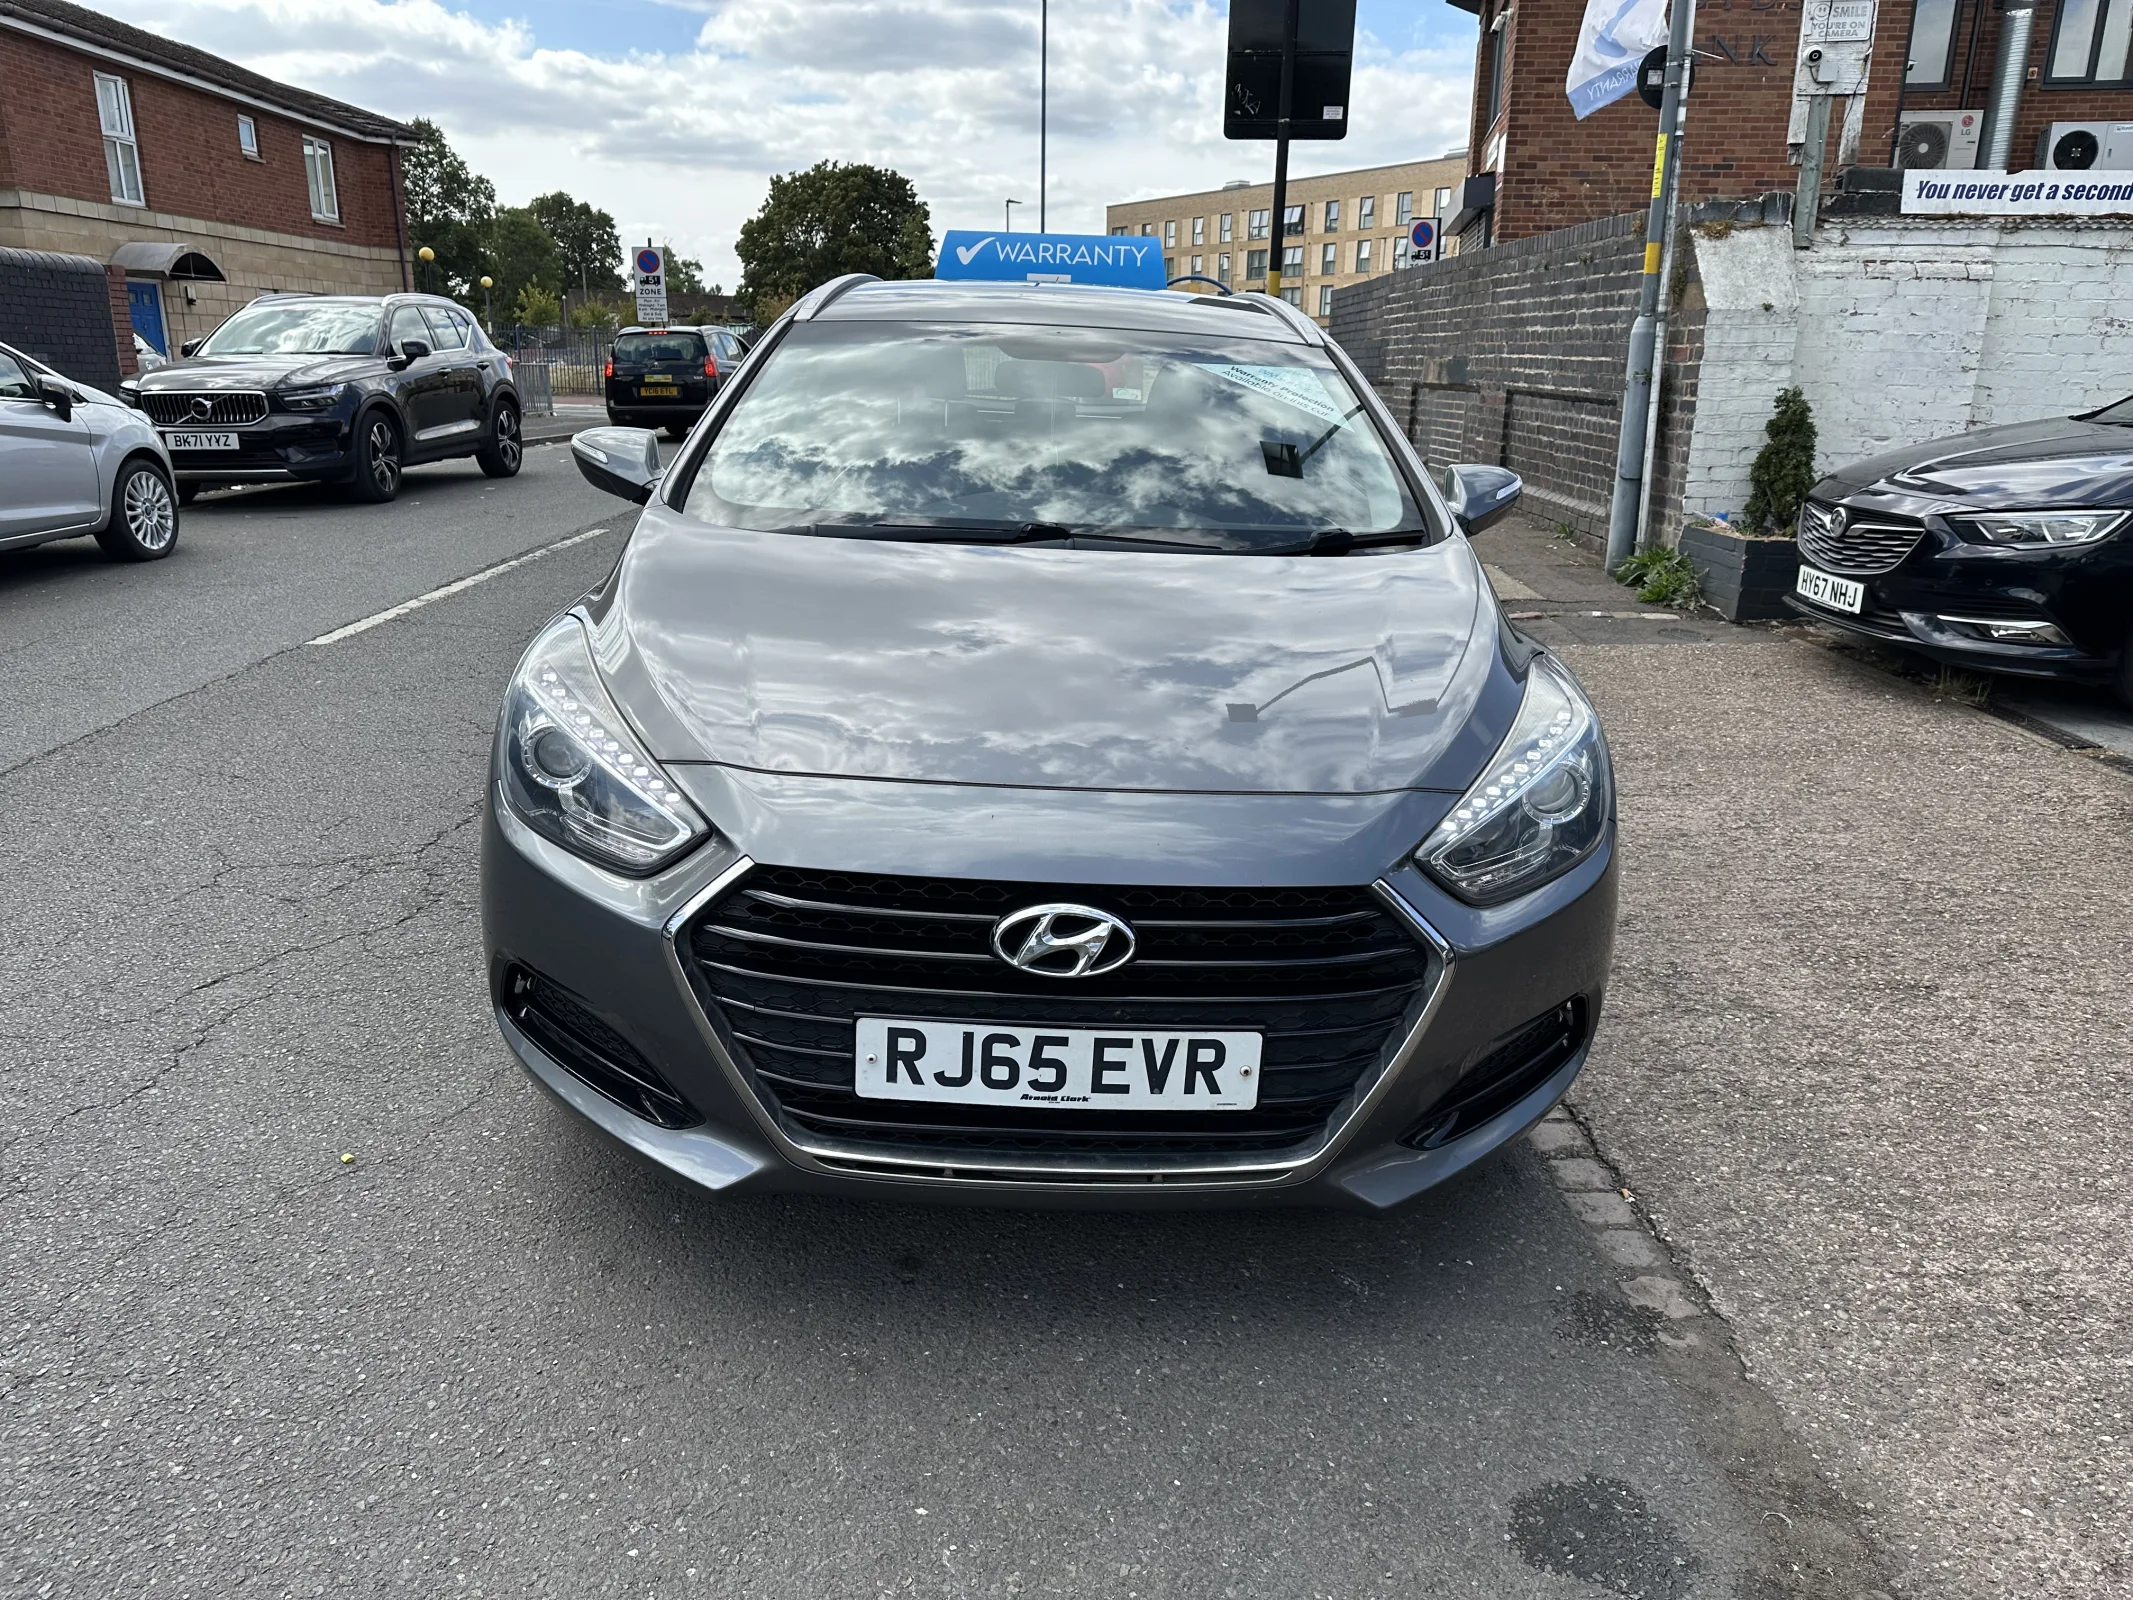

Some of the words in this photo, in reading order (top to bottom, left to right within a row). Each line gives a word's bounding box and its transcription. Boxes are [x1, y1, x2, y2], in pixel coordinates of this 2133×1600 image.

[1833, 6, 1868, 17] SMILE
[1812, 22, 1847, 30] YOU'RE
[1850, 21, 1866, 29] ON
[1961, 128, 1971, 136] LG
[1917, 180, 1951, 200] You
[1952, 182, 2009, 200] never
[2008, 182, 2046, 202] get
[2046, 184, 2060, 200] a
[2062, 182, 2133, 201] second
[996, 241, 1149, 267] WARRANTY
[660, 387, 673, 395] ETL
[1221, 370, 1271, 392] Available
[1272, 391, 1286, 400] on
[1311, 407, 1331, 417] car
[1230, 365, 1279, 388] Warranty
[1280, 386, 1335, 412] Protection
[173, 434, 203, 447] BK71
[204, 434, 231, 447] YYZ
[1801, 570, 1829, 598] HY67
[1829, 580, 1858, 608] NHJ
[885, 1026, 1070, 1093] RJ65
[1091, 1037, 1227, 1095] EVR
[1020, 1093, 1059, 1102] Arnold
